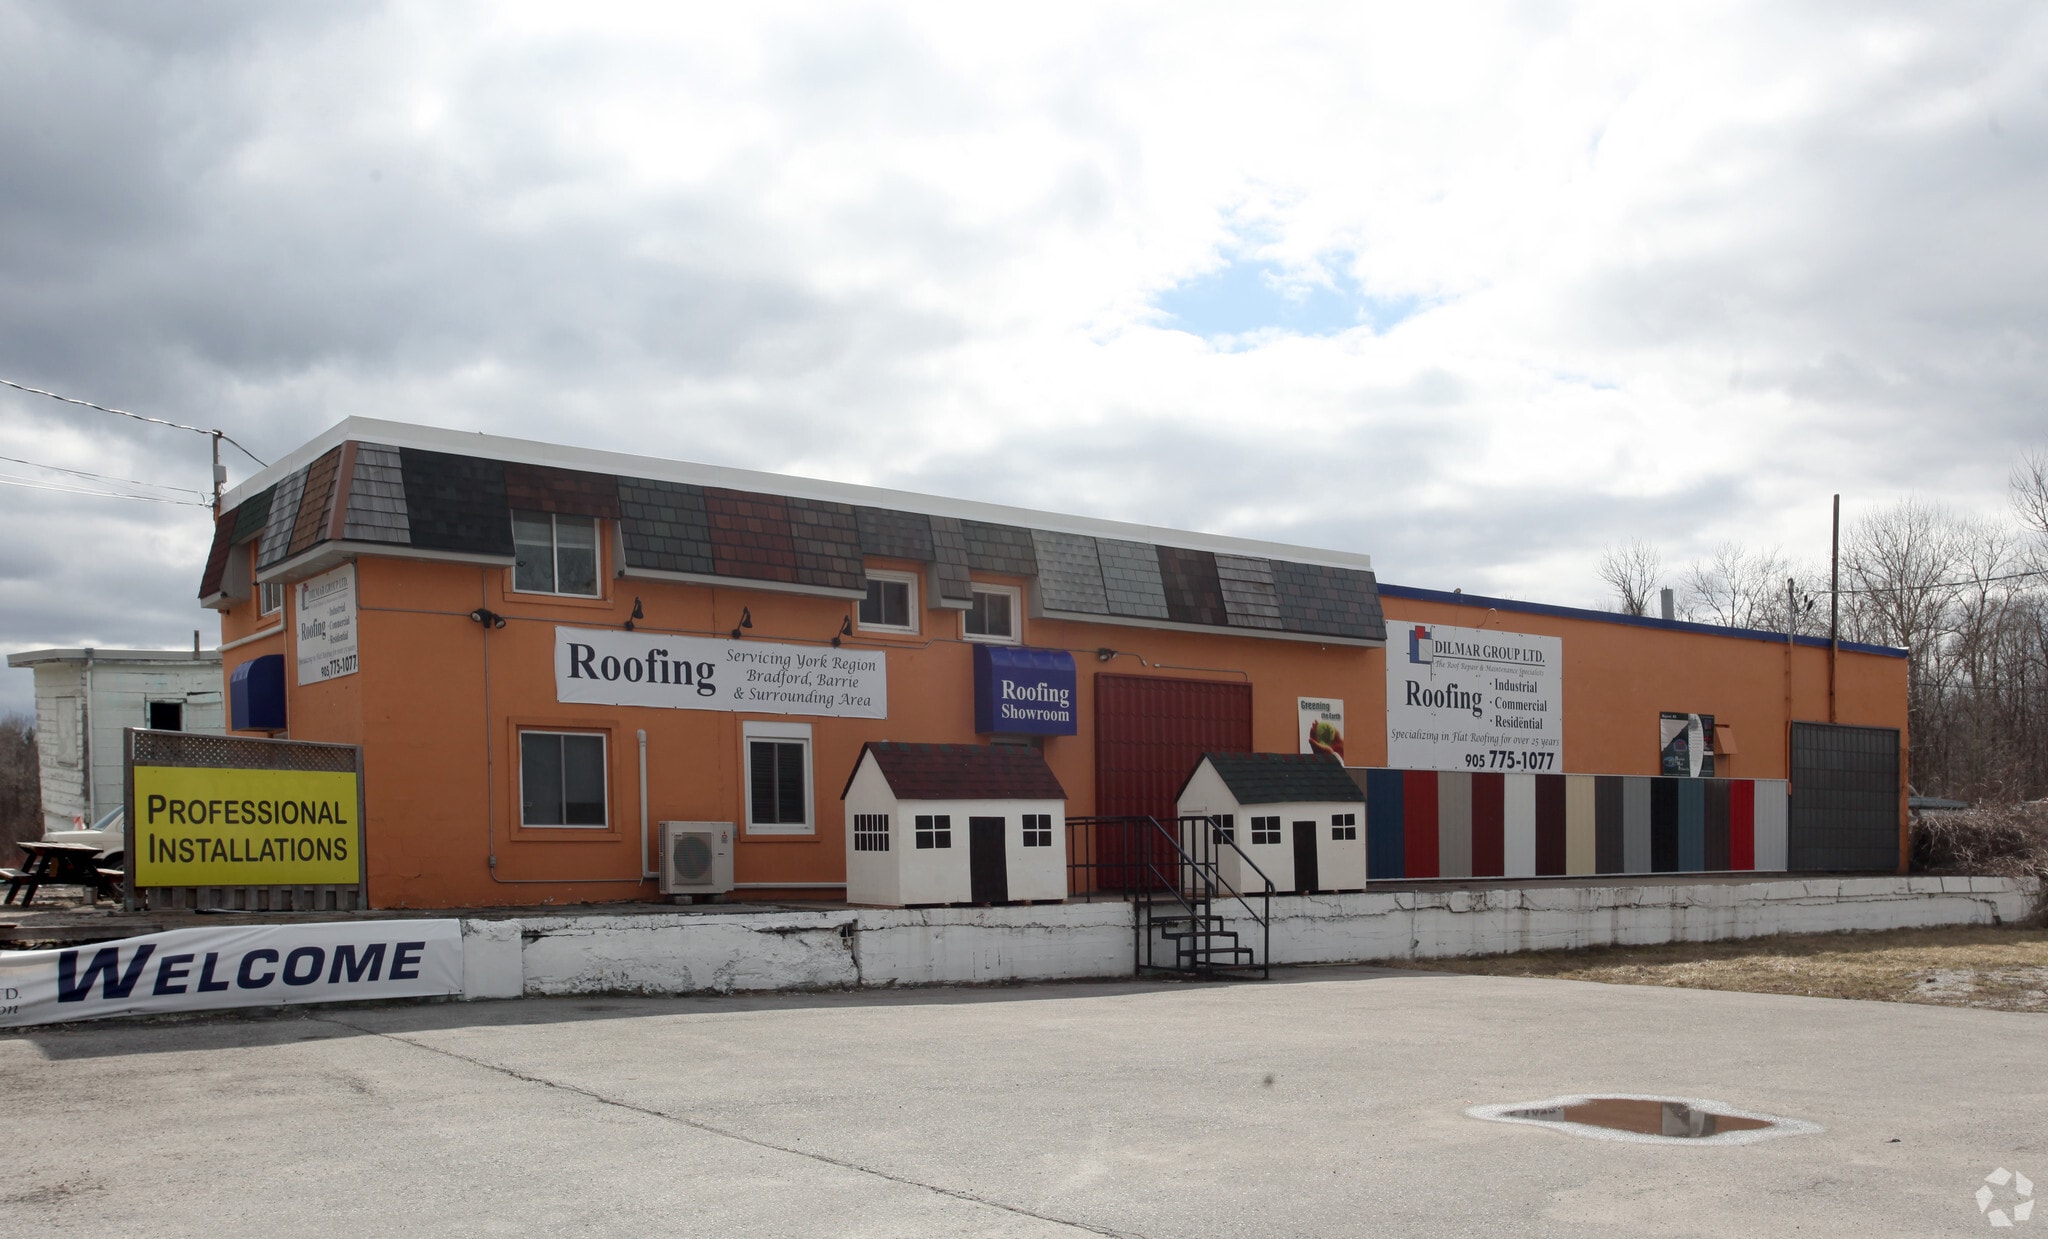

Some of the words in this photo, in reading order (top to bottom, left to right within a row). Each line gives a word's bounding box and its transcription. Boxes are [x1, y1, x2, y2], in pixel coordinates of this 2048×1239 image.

[301, 618, 326, 641] Roofing
[726, 648, 791, 670] Servicing
[797, 653, 827, 670] York
[831, 656, 877, 674] Region
[1434, 640, 1480, 657] DILMAR
[1483, 645, 1520, 661] GROUP
[1523, 649, 1545, 663] LTD.
[321, 665, 330, 678] 905
[329, 654, 357, 676] 775-1077
[566, 642, 716, 697] Roofing
[1435, 660, 1445, 669] The
[1447, 661, 1459, 671] Roof
[1460, 663, 1479, 673] Repair
[746, 669, 812, 688] Bradford,
[816, 673, 859, 688] Barrie
[1494, 678, 1538, 694] Industrial
[733, 686, 745, 700] &
[748, 687, 835, 709] Surrounding
[838, 693, 872, 707] Area
[1001, 679, 1070, 709] Roofing
[1300, 700, 1330, 711] Greening
[1405, 680, 1483, 718] Roofing
[1494, 696, 1548, 712] Commercial
[1001, 703, 1070, 722] Showroom
[1329, 712, 1341, 720] Earth
[1495, 714, 1543, 730] Residential
[1391, 728, 1439, 744] Specializing
[1441, 731, 1450, 741] in
[1451, 731, 1469, 744] Flat
[1470, 733, 1499, 746] Roofing
[1500, 734, 1512, 747] for
[1513, 737, 1530, 745] over
[1531, 737, 1540, 748] 25
[1541, 737, 1560, 749] years
[1465, 753, 1486, 768] 905
[1489, 750, 1555, 770] 775-1077
[147, 794, 348, 825] PROFESSIONAL
[149, 832, 348, 863] INSTALLATIONS
[57, 941, 426, 1004] WELCOME
